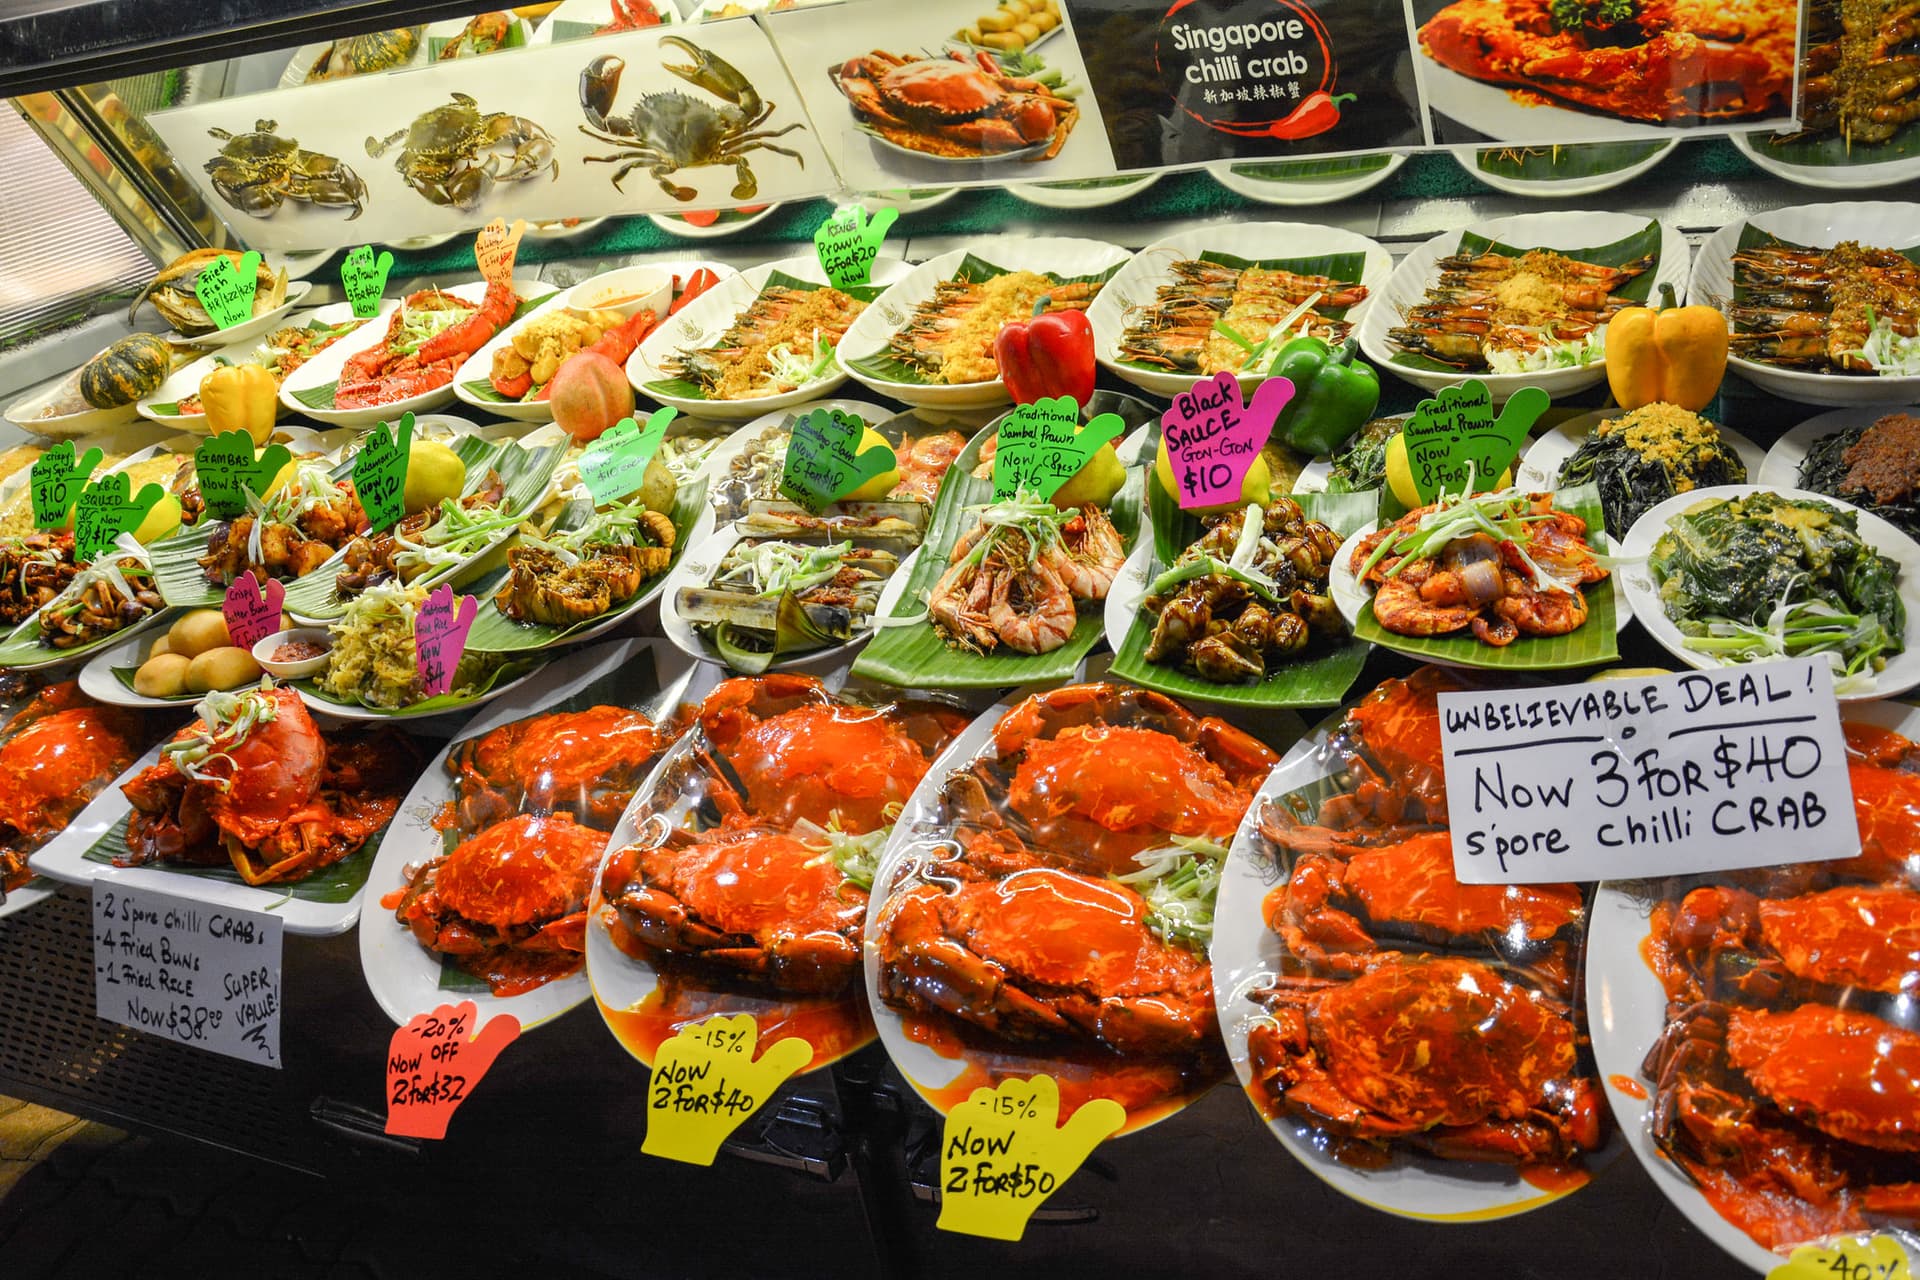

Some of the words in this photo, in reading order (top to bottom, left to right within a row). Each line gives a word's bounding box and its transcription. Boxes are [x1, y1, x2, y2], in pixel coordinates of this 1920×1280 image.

[1171, 19, 1304, 51] Singapore
[1185, 55, 1242, 83] chilli
[1247, 50, 1308, 78] crab
[1203, 81, 1301, 104] 新加坡辣椒蟹
[818, 235, 862, 257] Prawn
[841, 268, 865, 285] Now
[223, 310, 246, 326] Now
[1178, 381, 1234, 421] Black
[1420, 394, 1489, 418] Traditional
[1016, 407, 1077, 424] Traditional
[1406, 417, 1456, 437] Sambal
[1456, 413, 1495, 434] Prawn
[1000, 422, 1038, 439] Sambal
[1040, 424, 1075, 444] Prawn
[1165, 409, 1241, 453] SAUCE
[197, 449, 249, 467] GAMBAS
[1002, 451, 1035, 468] Now
[1416, 446, 1450, 465] Now
[1009, 466, 1043, 489] $16
[1183, 463, 1233, 498] $10
[38, 483, 67, 507] $10
[80, 493, 123, 509] SQUID
[92, 524, 120, 546] $12
[424, 660, 446, 689] $4
[1446, 685, 1669, 735] UNBELIEVABLE
[1591, 749, 1630, 808] 3
[1714, 734, 1822, 789] $40
[1597, 805, 1691, 848] chilli
[1711, 791, 1827, 836] CRAB
[119, 930, 158, 965] Fried
[121, 963, 156, 990] Fried
[223, 966, 272, 1002] SUPER
[411, 1013, 468, 1041] -20%
[430, 1041, 460, 1064] OFF
[694, 1030, 747, 1054] -15%
[979, 1094, 1038, 1120] -15%
